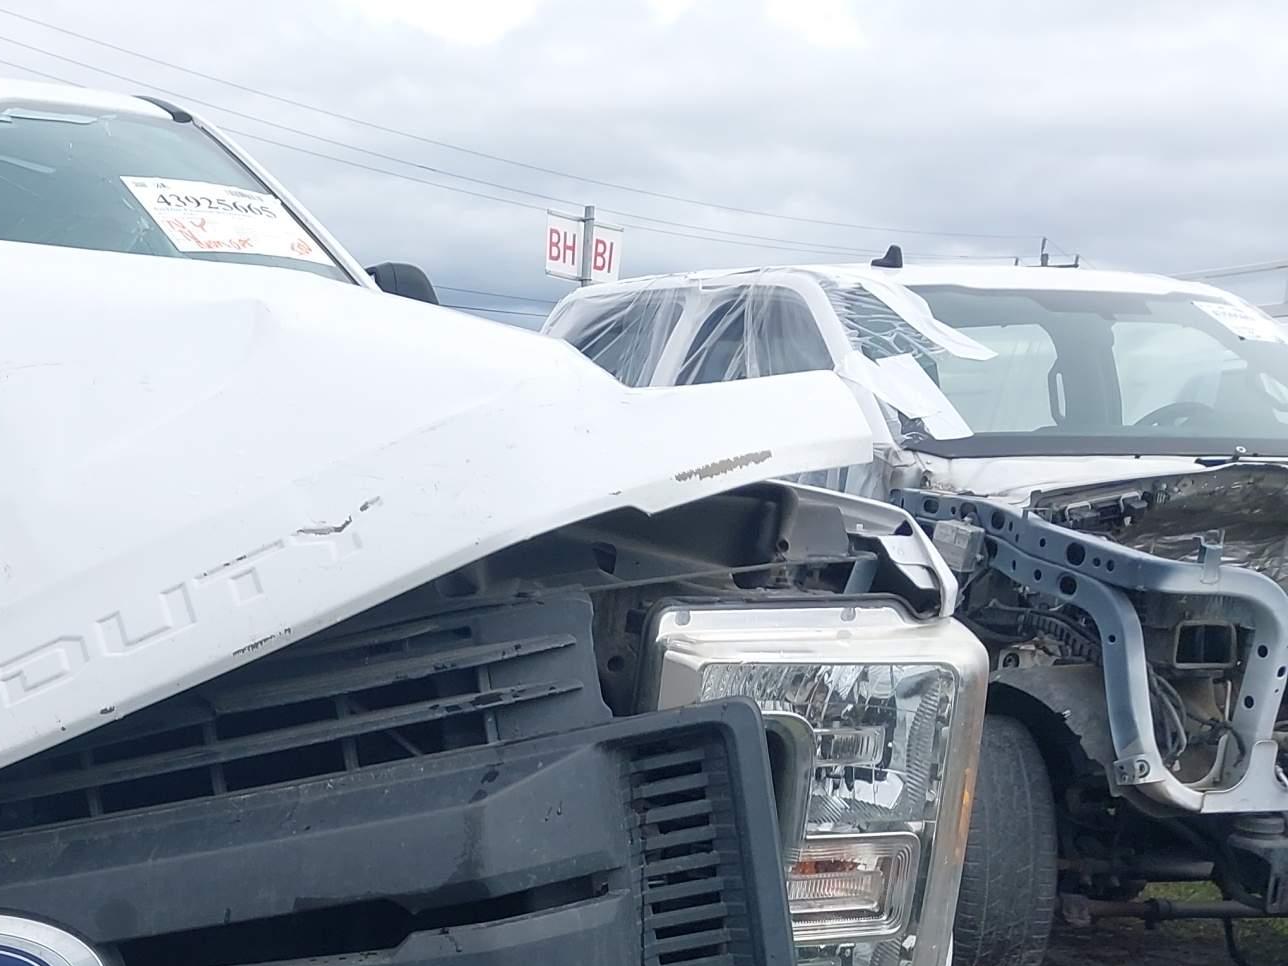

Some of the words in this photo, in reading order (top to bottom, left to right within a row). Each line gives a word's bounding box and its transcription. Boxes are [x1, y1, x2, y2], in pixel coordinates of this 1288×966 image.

[156, 193, 278, 219] 43925665
[548, 228, 577, 266] BH
[592, 238, 614, 274] BI
